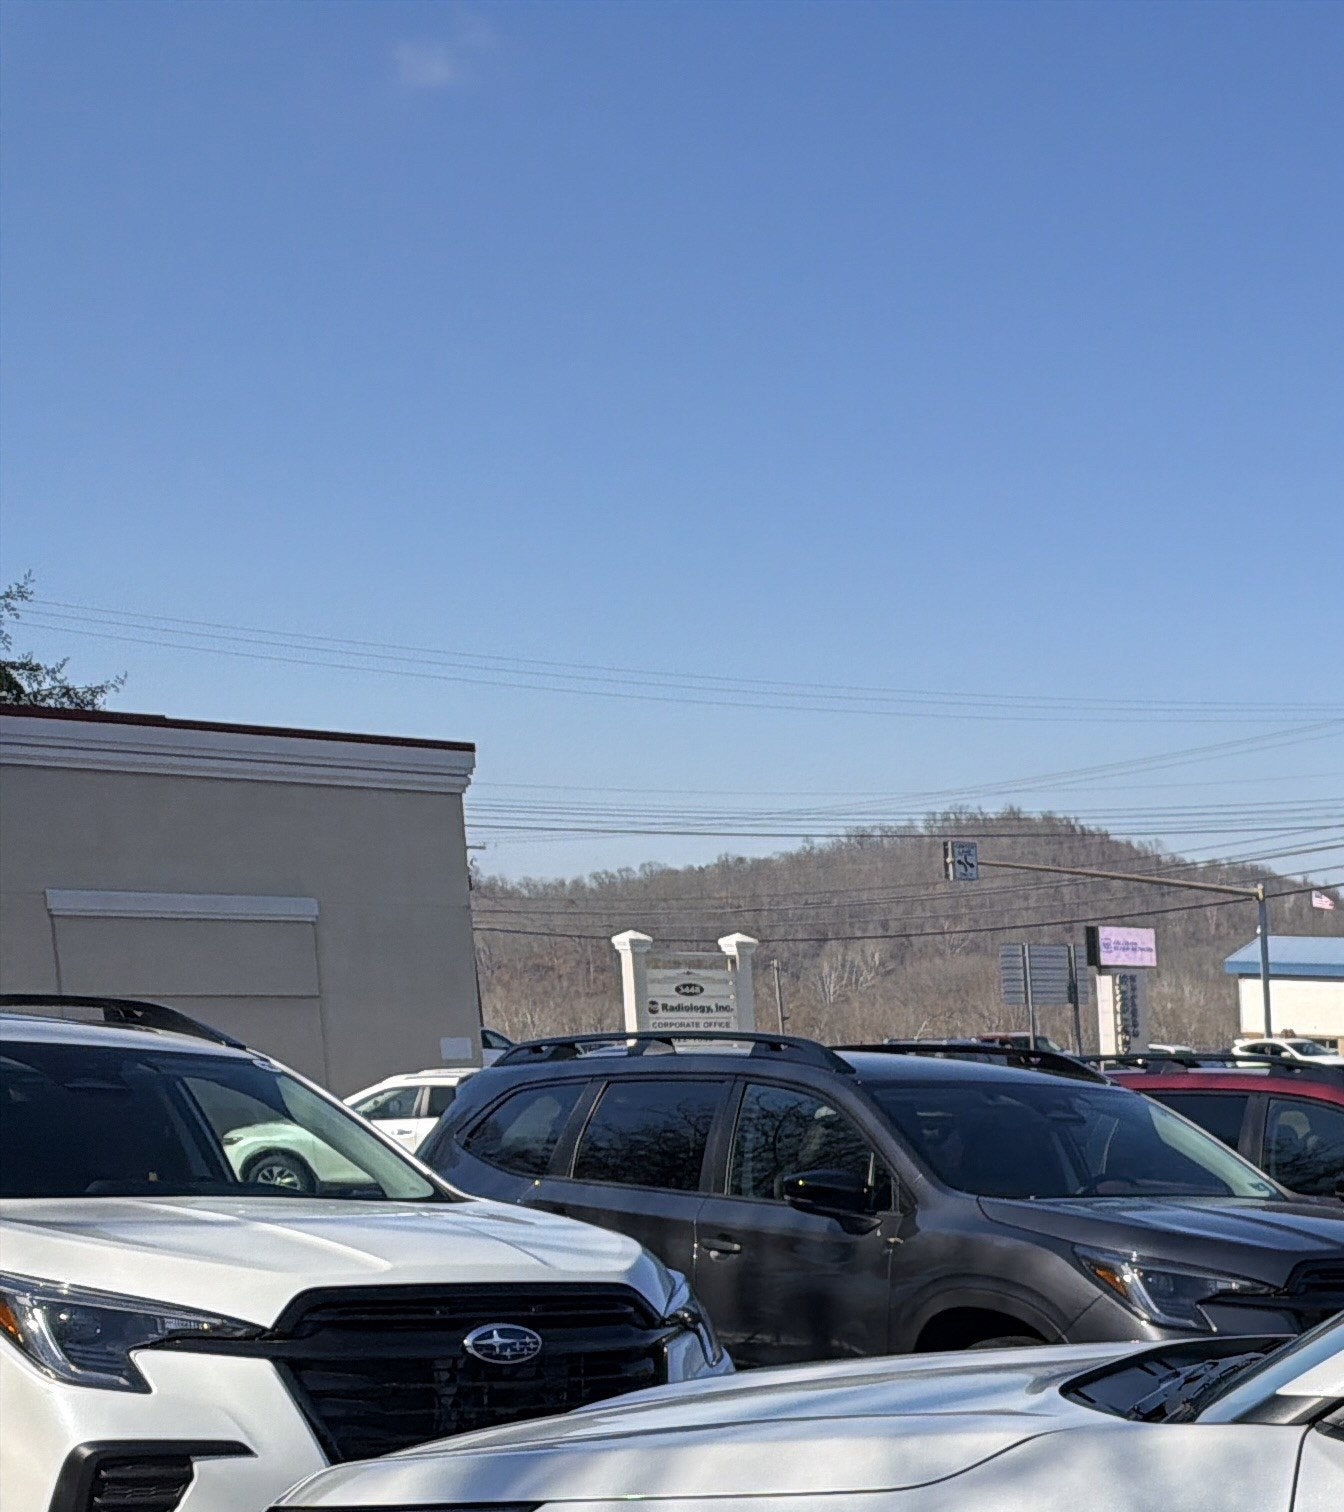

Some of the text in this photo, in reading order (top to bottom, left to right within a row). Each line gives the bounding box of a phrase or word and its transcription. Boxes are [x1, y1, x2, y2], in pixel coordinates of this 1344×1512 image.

[661, 1003, 713, 1014] Radiology,
[652, 1021, 731, 1029] CORPORATE OFFICE
